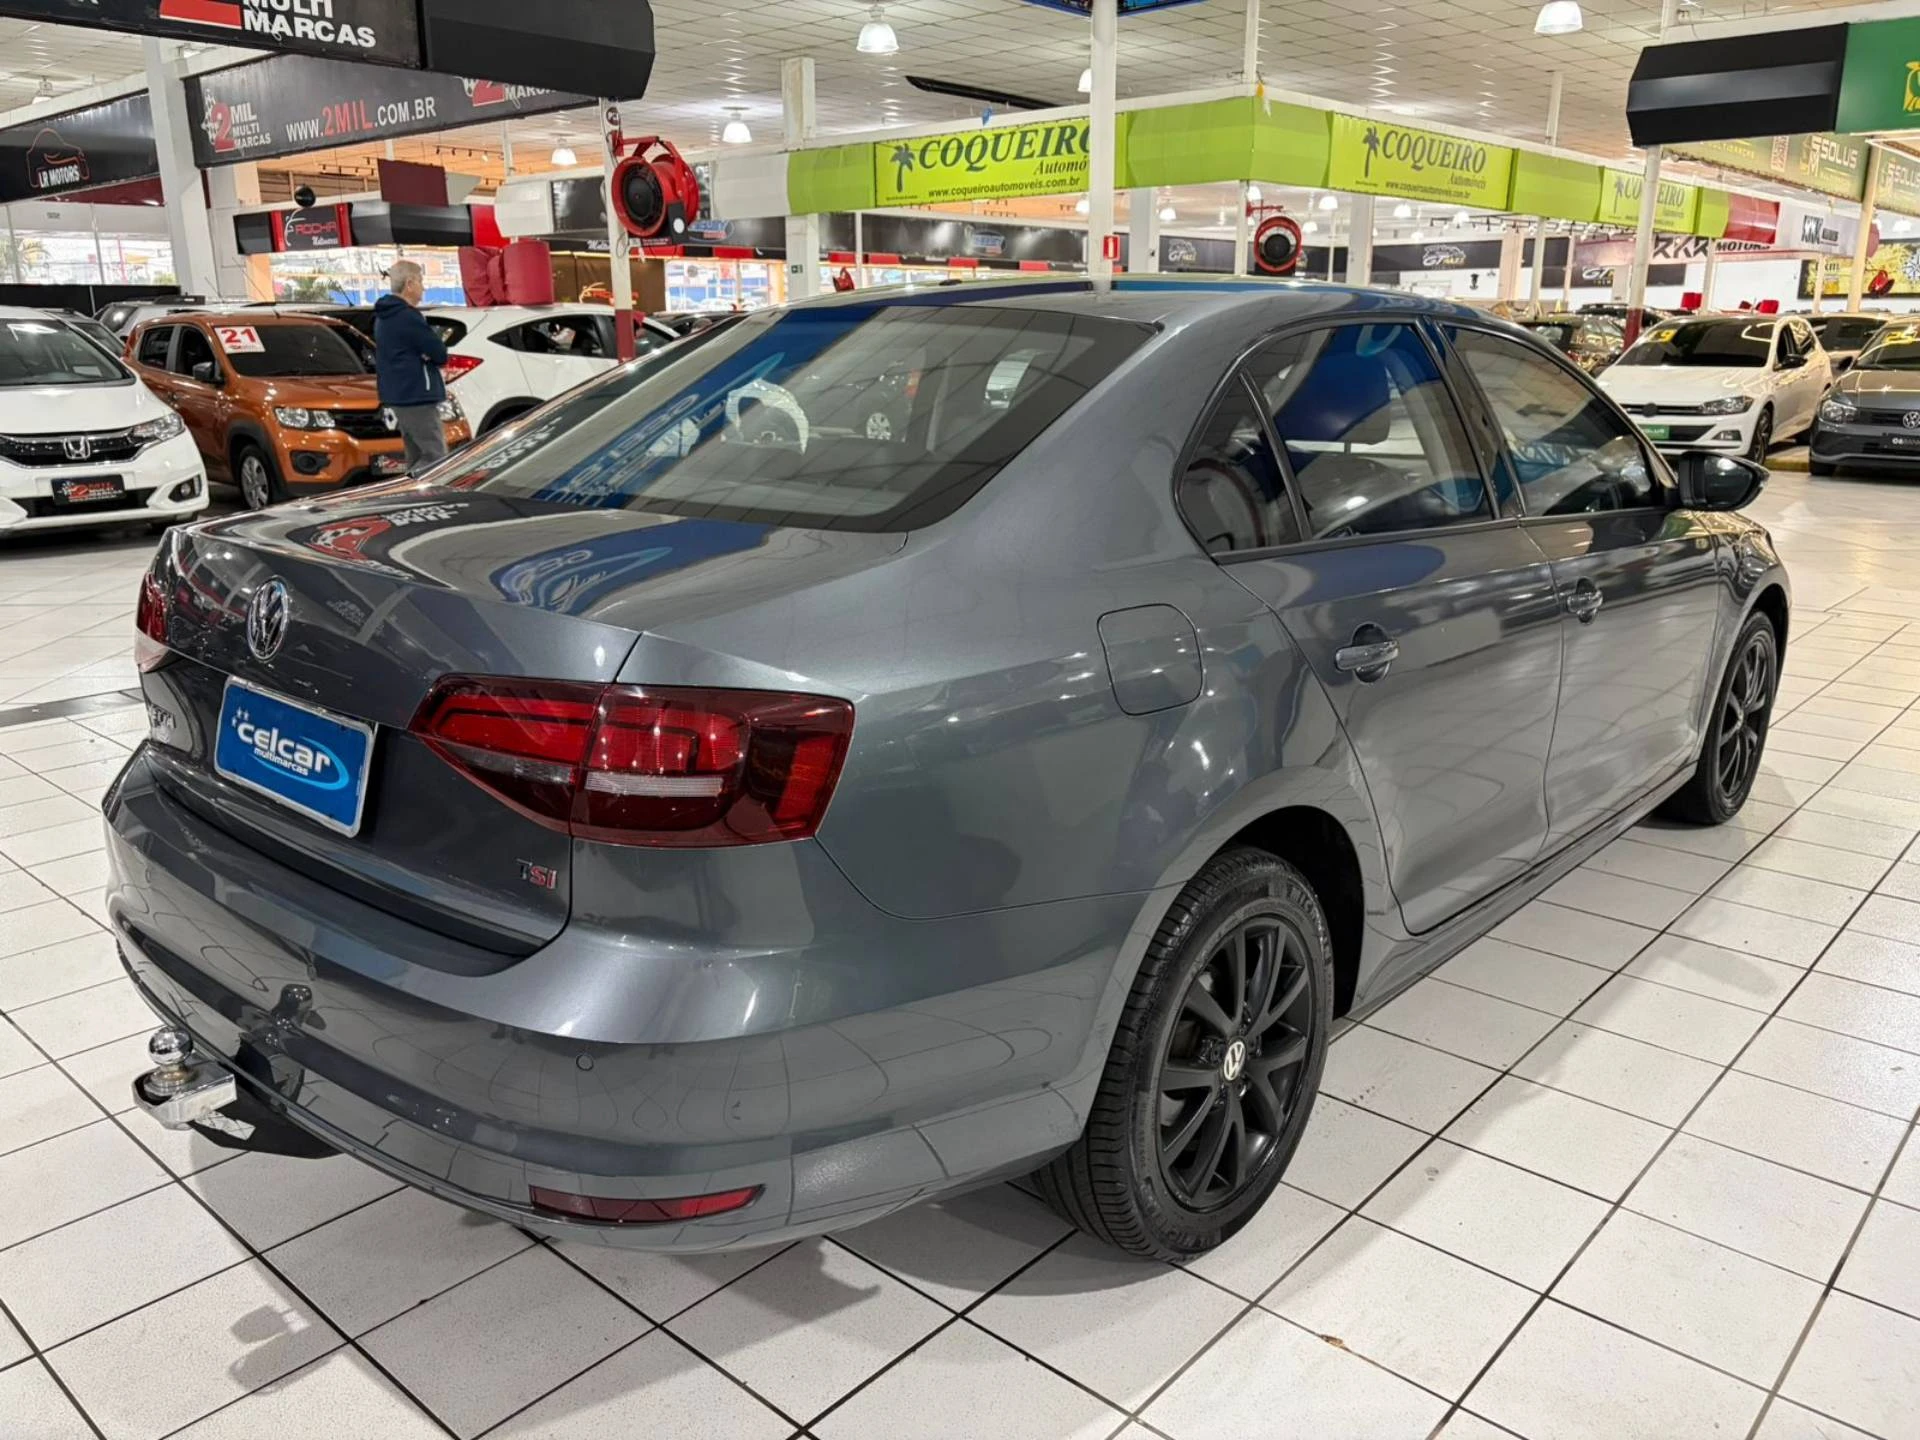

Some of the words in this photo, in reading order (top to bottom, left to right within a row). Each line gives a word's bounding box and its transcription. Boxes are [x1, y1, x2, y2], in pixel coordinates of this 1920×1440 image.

[243, 9, 376, 48] MARCAS
[230, 102, 257, 124] MIL
[232, 122, 260, 139] MULTI
[234, 132, 271, 150] MARCAS
[1382, 130, 1486, 173] COQUEIRO
[48, 164, 80, 186] MOTORS
[1033, 155, 1087, 175] Automó
[928, 176, 1080, 198] www.coqueiroautomoveis.com.br
[1625, 176, 1685, 207] COEIRO
[221, 328, 256, 343] 21
[237, 721, 331, 773] celcar
[254, 747, 308, 776] multimarcas
[516, 858, 558, 889] TSI
